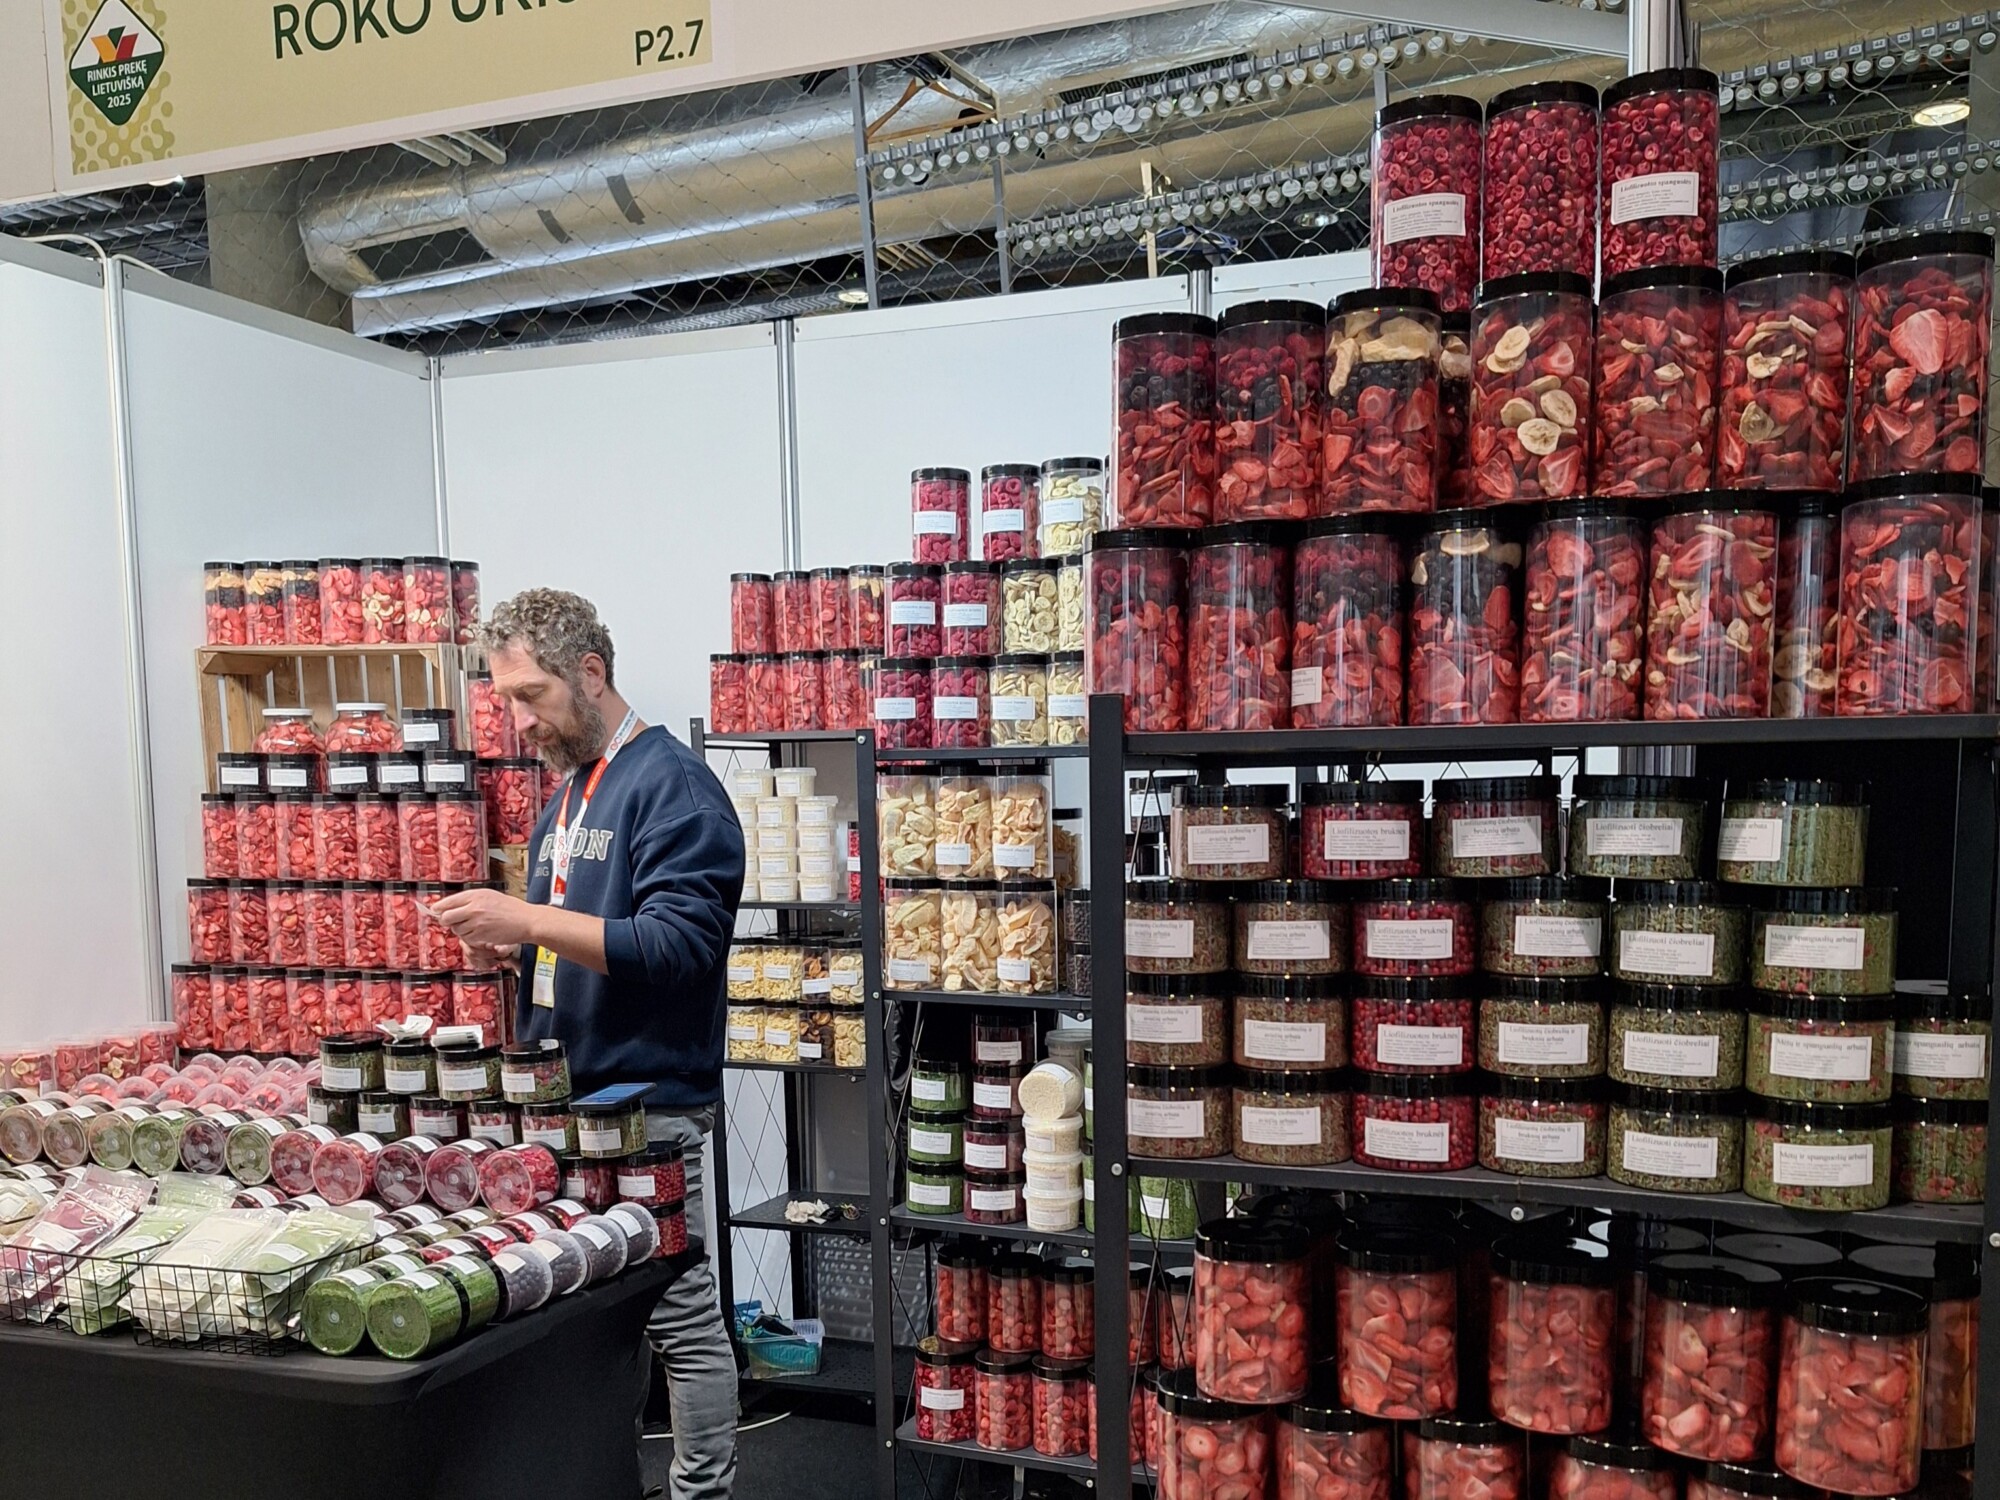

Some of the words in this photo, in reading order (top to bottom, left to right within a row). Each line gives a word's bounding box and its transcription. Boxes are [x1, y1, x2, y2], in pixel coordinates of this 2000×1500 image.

[272, 0, 432, 59] ROKO
[634, 19, 704, 66] P2.7
[87, 65, 118, 82] RINKIS
[118, 60, 148, 75] PREKĘ
[92, 75, 145, 97] LIETUVIŠKĄ
[107, 93, 132, 109] 2025
[1595, 822, 1637, 831] Liofilizuoti
[1639, 821, 1674, 832] čiobreliai
[1429, 1031, 1458, 1040] bruknės
[1674, 1037, 1710, 1048] čiobreliai
[1415, 1127, 1445, 1139] bruknės
[1673, 1137, 1709, 1150] čiobreliai
